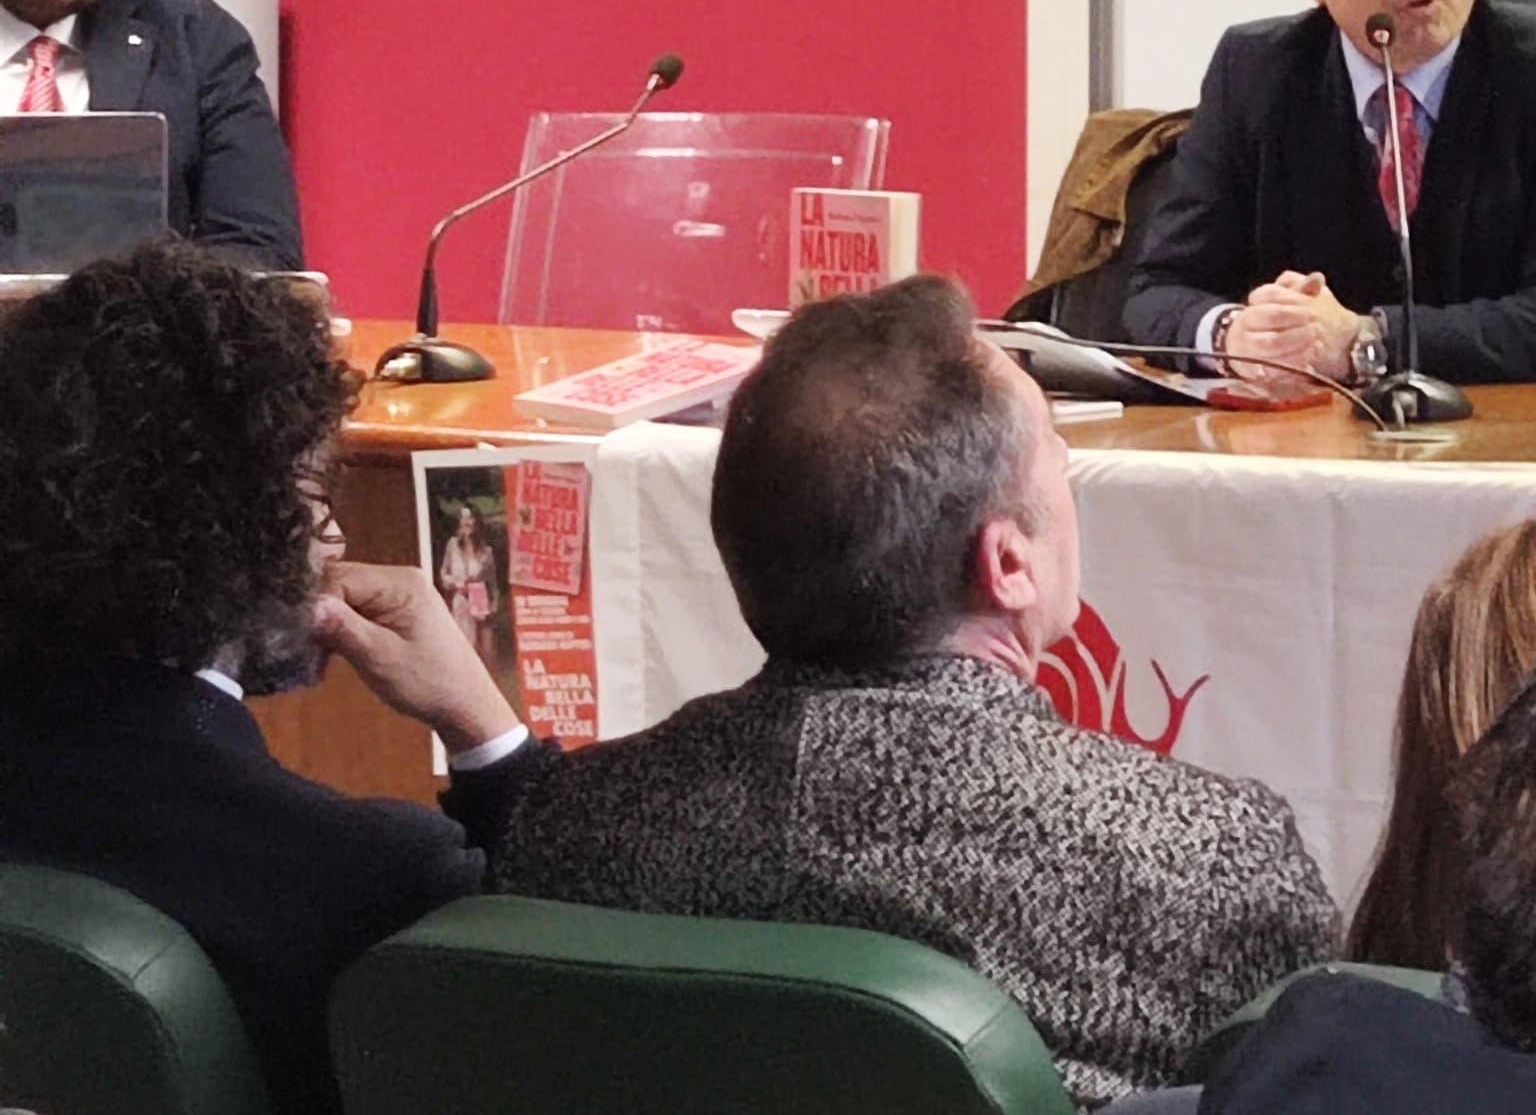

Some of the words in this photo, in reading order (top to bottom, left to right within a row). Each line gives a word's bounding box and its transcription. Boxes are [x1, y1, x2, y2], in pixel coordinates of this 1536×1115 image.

[801, 192, 824, 226] LA
[800, 229, 879, 273] NATURA
[523, 659, 546, 674] LA
[525, 673, 592, 690] NATURA
[545, 689, 594, 705] BELLA
[529, 705, 577, 722] DELLE
[553, 720, 594, 737] COSE
